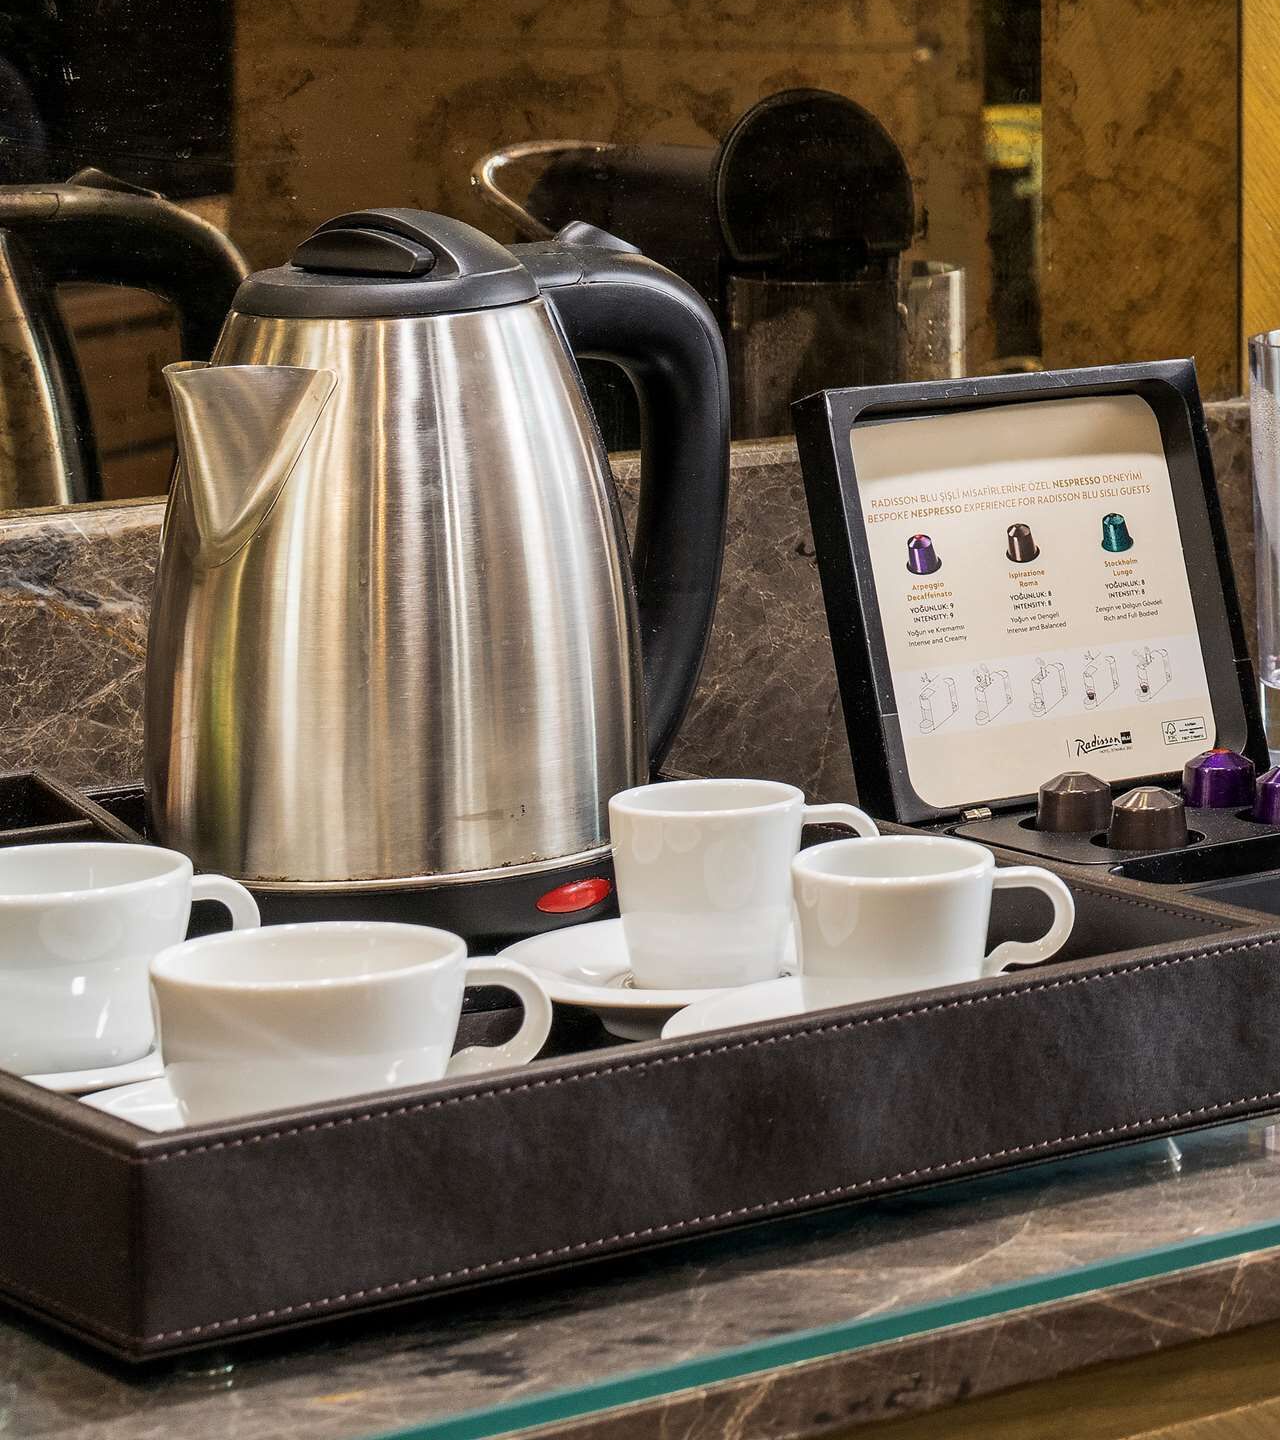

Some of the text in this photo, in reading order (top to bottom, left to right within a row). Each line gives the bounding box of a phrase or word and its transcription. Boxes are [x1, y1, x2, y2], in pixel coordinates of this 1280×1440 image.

[872, 496, 918, 508] RADISSON
[920, 493, 938, 502] BLU
[1053, 475, 1101, 488] NESPRESSO
[868, 510, 909, 523] BESPOKE
[911, 505, 962, 518] NESPRESSO
[964, 499, 1017, 512] EXPERIENCE
[1018, 496, 1035, 506] FOR
[1037, 491, 1080, 504] RADISSON
[1082, 490, 1098, 499] BLU
[1120, 485, 1150, 495] GUESTS
[1104, 558, 1137, 567] Stockholm
[912, 581, 945, 591] Arpeggio
[907, 591, 953, 601] Decaffeinato
[1075, 734, 1120, 757] Radisson
